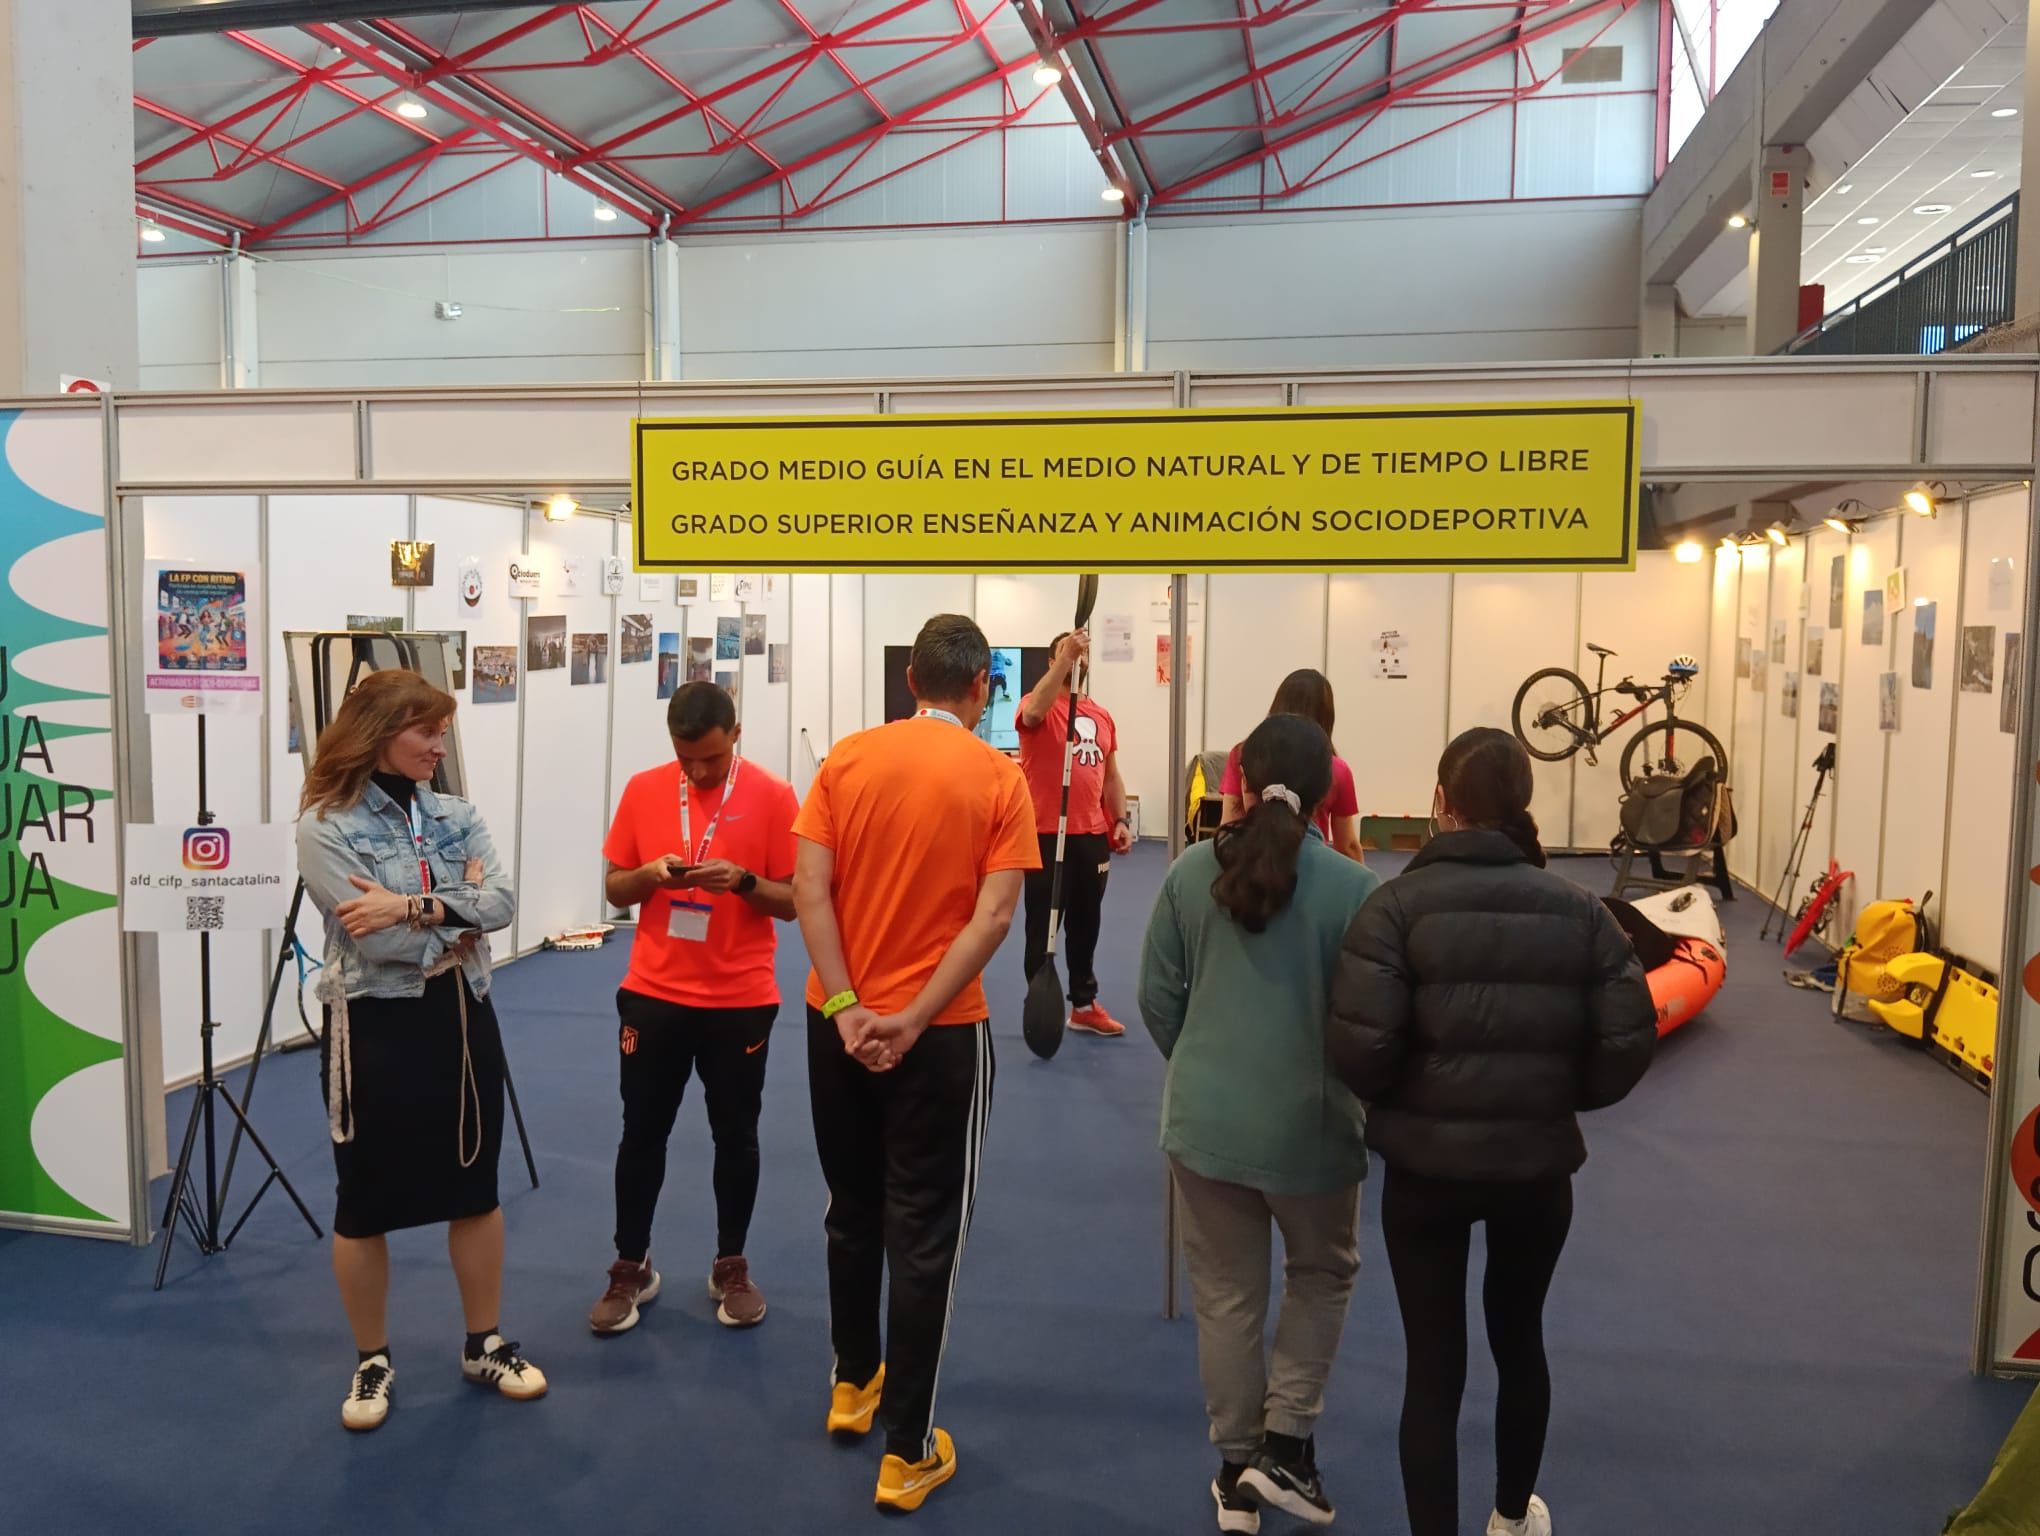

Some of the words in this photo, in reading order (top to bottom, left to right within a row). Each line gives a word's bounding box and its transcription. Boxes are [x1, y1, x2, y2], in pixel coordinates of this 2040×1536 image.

[672, 460, 769, 481] GRADO
[779, 460, 866, 480] MEDIO
[876, 454, 944, 480] GUÍA
[954, 458, 990, 479] EN
[1001, 458, 1034, 479] EL
[1044, 457, 1136, 478] MEDIO
[1147, 455, 1286, 477] NATURAL
[1292, 454, 1311, 475] Y
[1322, 453, 1361, 475] DE
[1371, 451, 1488, 474] TIEMPO
[1500, 449, 1589, 472] LIBRE
[671, 514, 768, 534] GRADO
[777, 514, 913, 534] SUPERIOR
[924, 508, 1098, 534] ENSEÑANZA
[1105, 512, 1123, 533] Y
[1130, 506, 1300, 533] ANIMACIÓN
[1312, 507, 1589, 532] SOCIODEPORTIVA
[169, 574, 180, 583] LA
[181, 574, 191, 583] FP
[192, 574, 209, 584] CON
[210, 575, 237, 585] RITMO
[129, 874, 281, 889] afd_cifp_santacatalina
